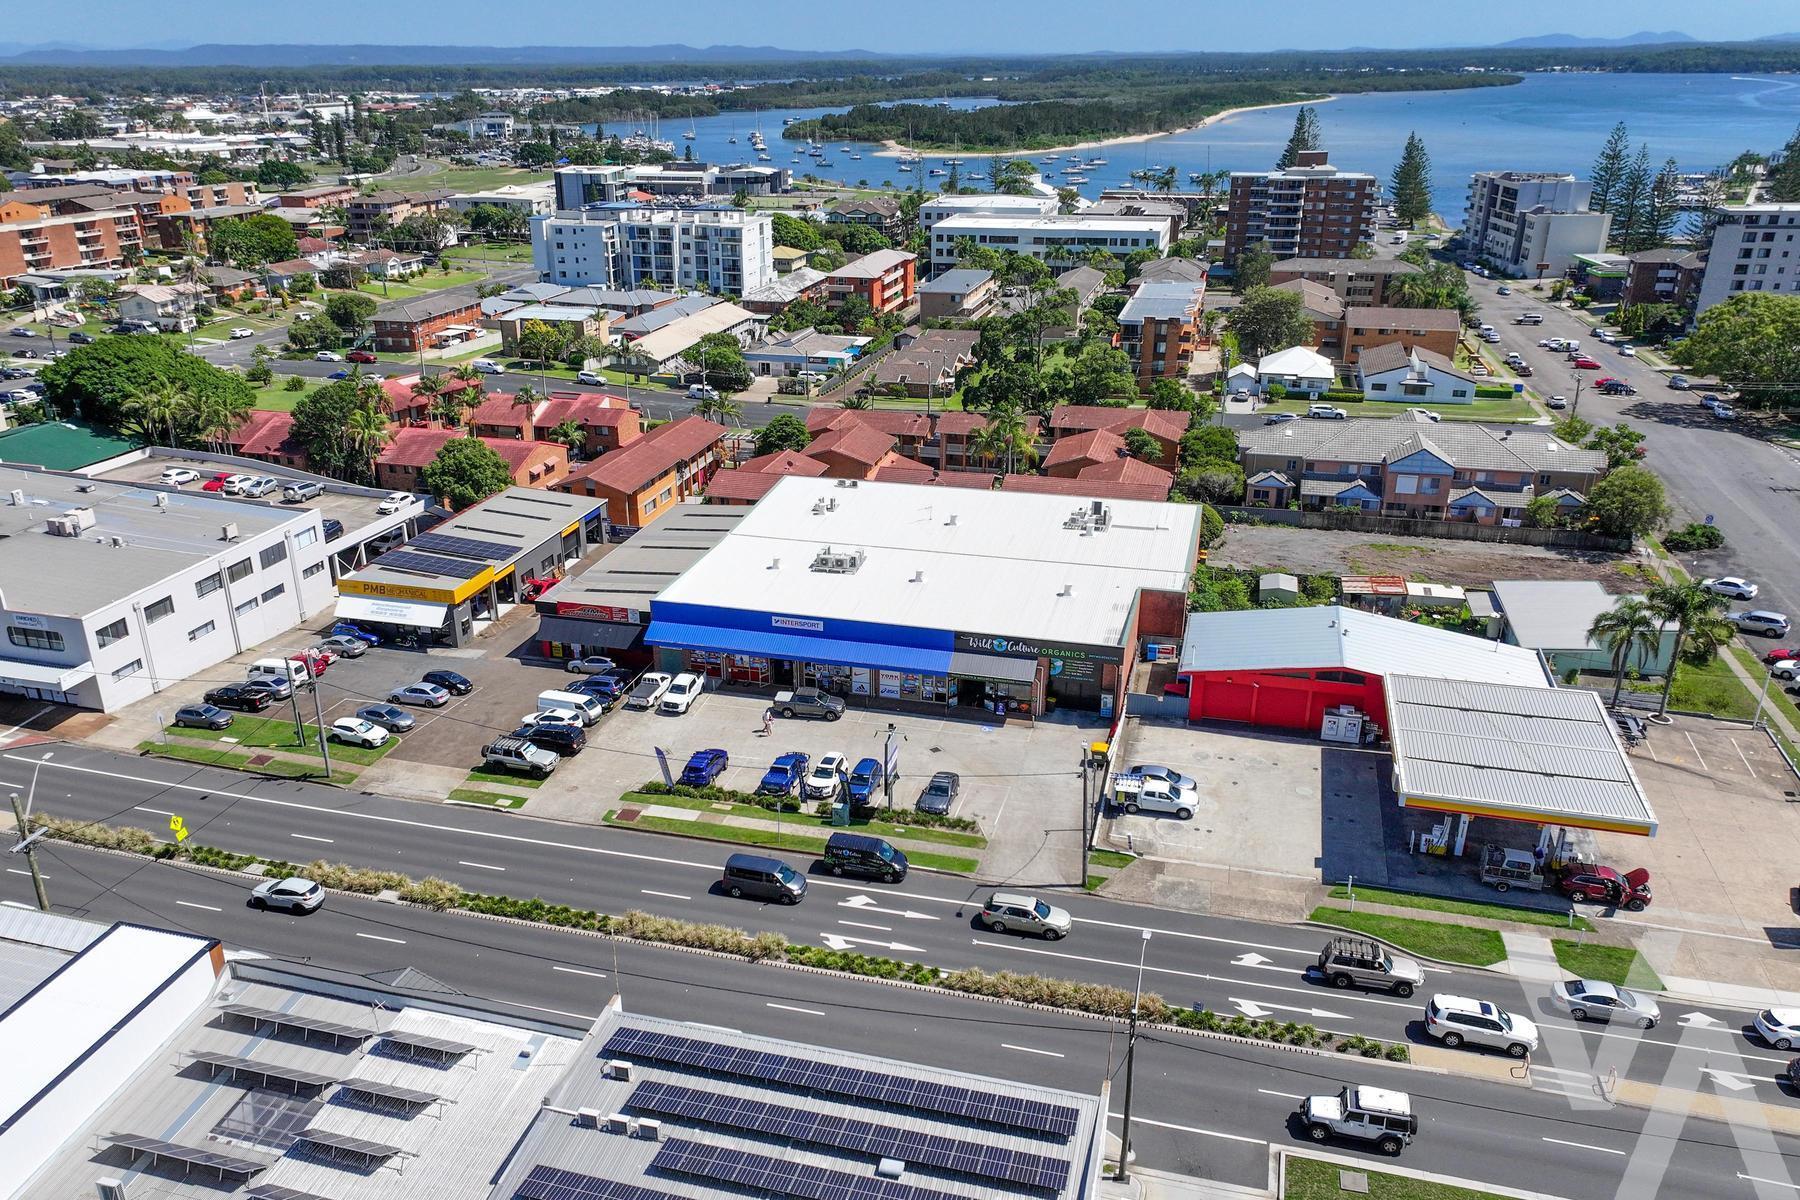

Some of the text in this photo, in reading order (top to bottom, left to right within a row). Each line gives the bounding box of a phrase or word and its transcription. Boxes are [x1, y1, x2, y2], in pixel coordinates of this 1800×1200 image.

[363, 583, 386, 595] PMB
[780, 619, 820, 629] INTERSPORT
[960, 635, 993, 650] Wild
[1007, 641, 1040, 654] Culture
[1041, 647, 1086, 659] ORGANICS
